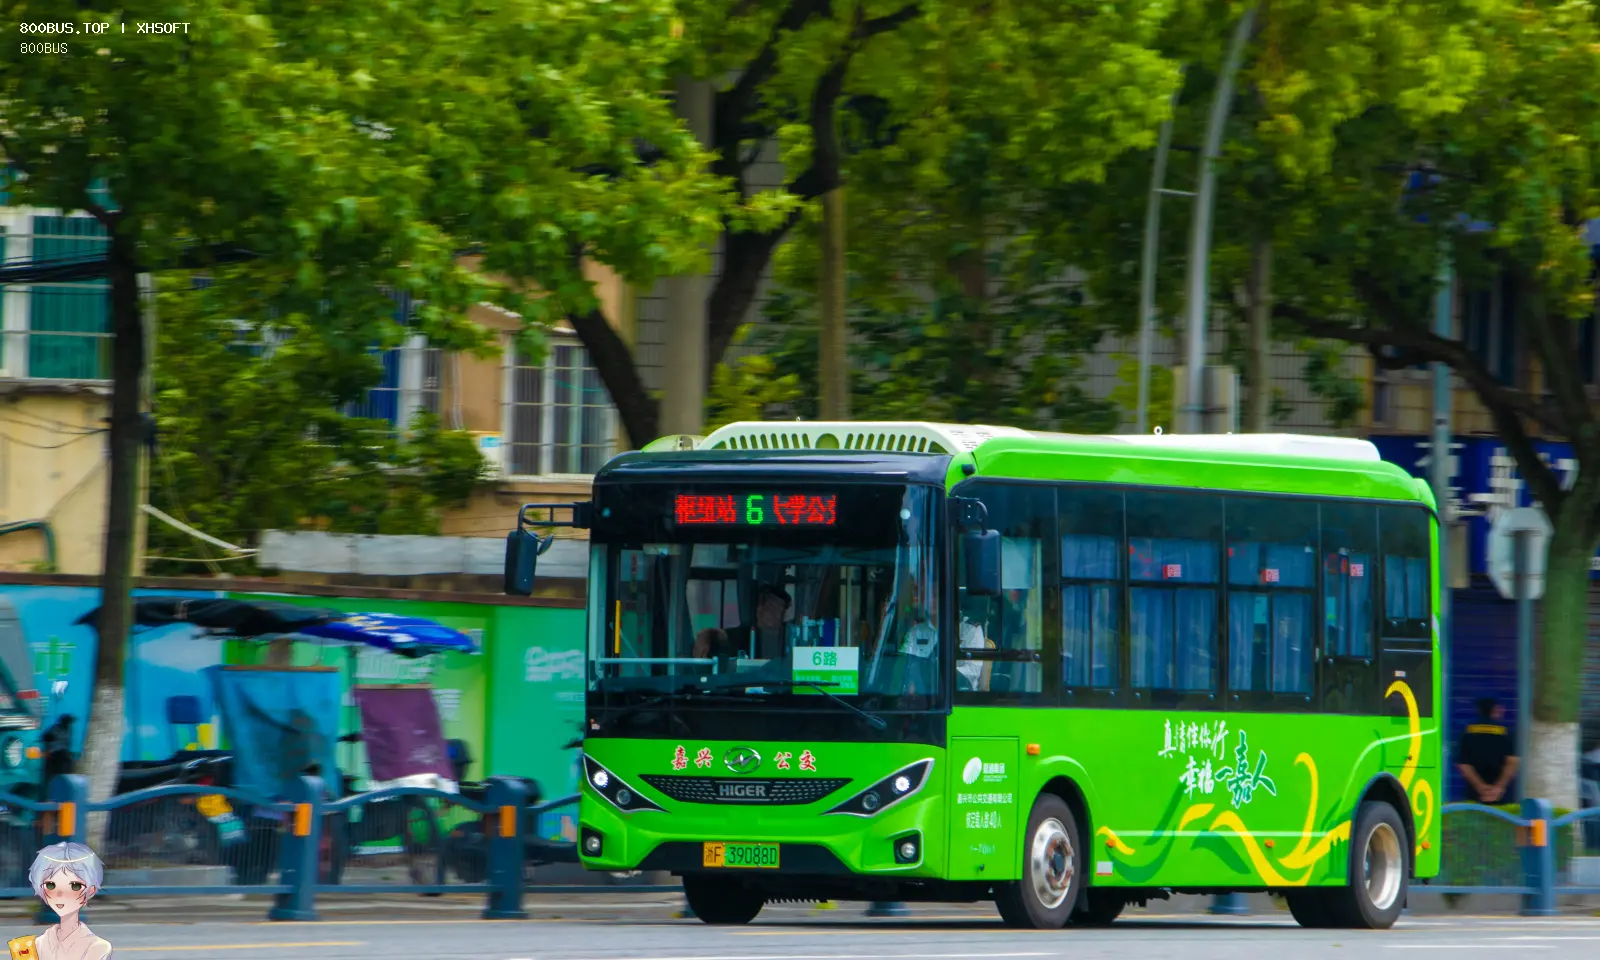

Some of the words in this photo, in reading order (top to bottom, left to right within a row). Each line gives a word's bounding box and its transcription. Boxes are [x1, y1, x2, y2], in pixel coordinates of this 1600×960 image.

[675, 494, 736, 524] 枢纽站
[746, 495, 764, 525] 6
[812, 651, 837, 667] 6路
[671, 745, 713, 771] 嘉兴
[774, 749, 816, 772] 公交
[719, 784, 766, 797] HIGER
